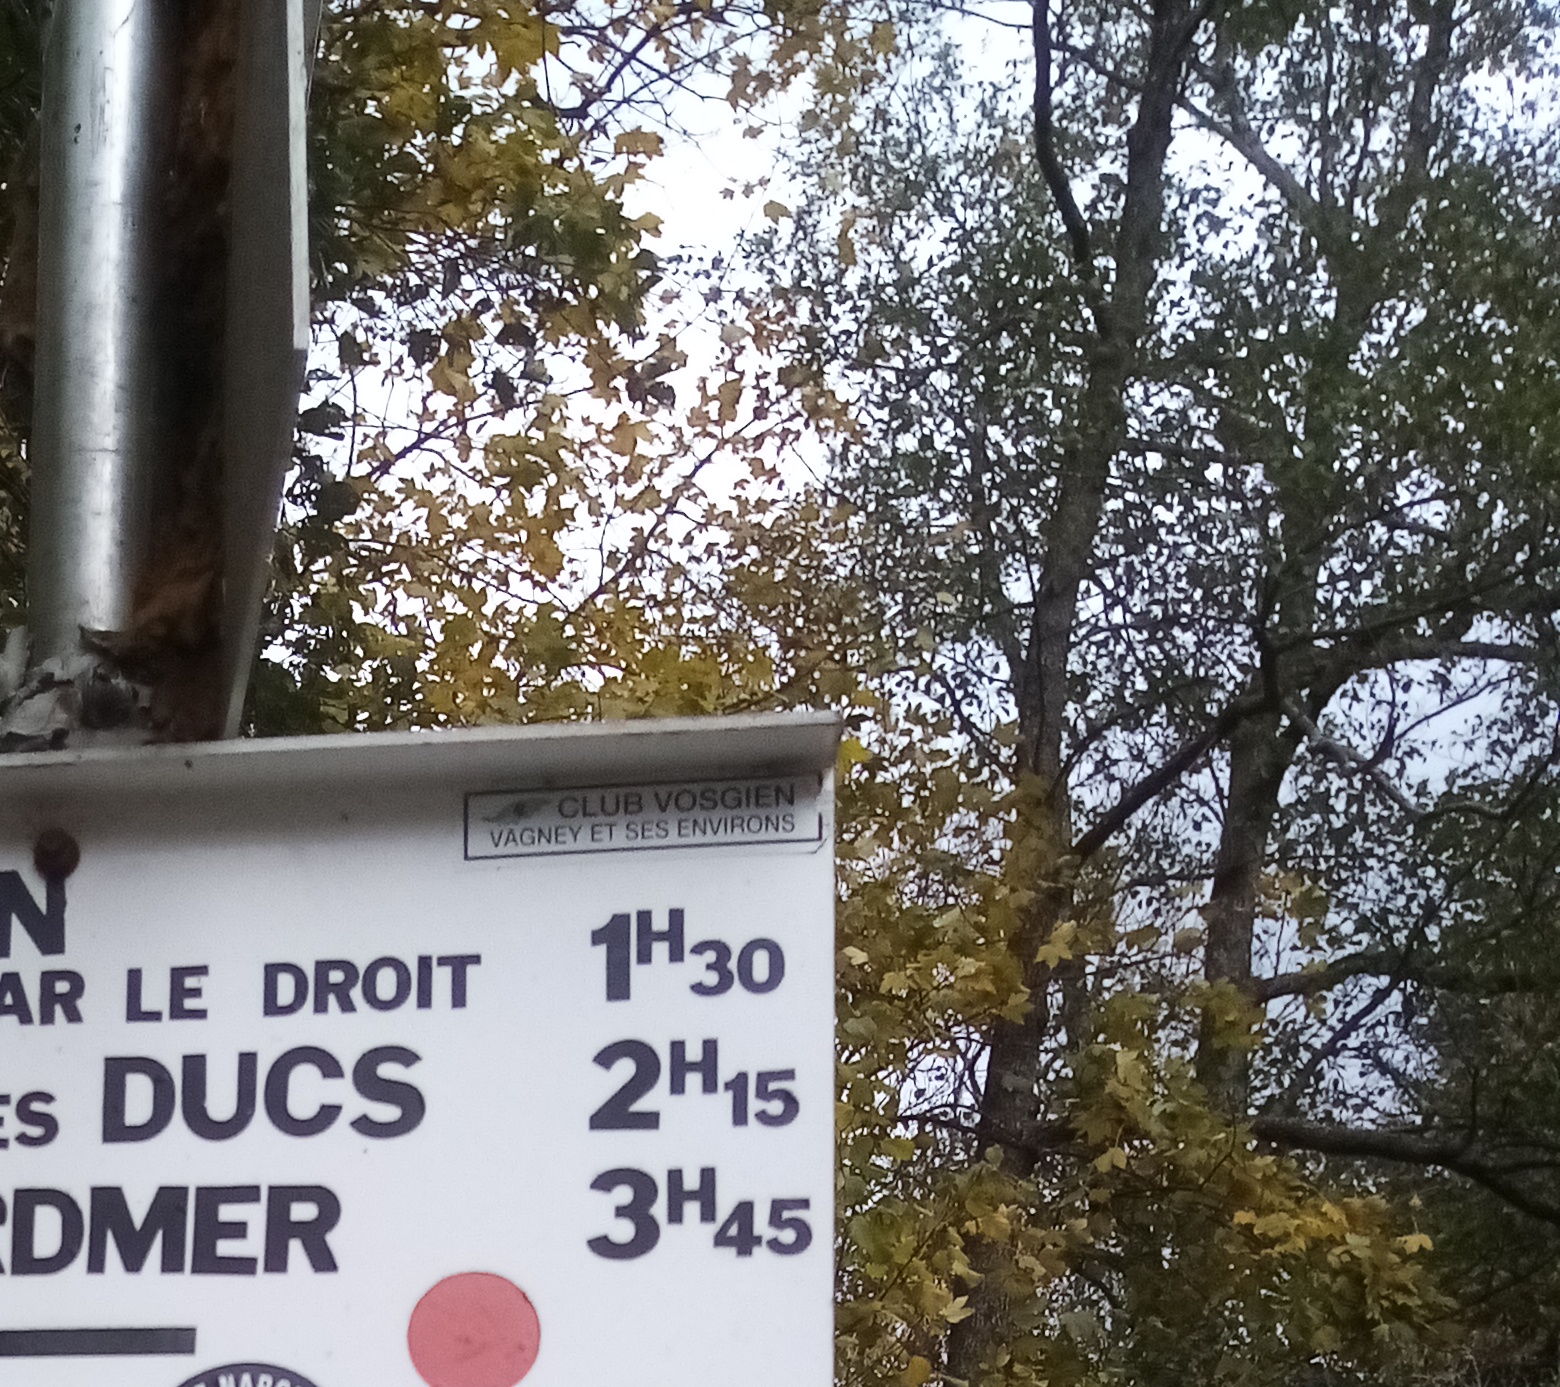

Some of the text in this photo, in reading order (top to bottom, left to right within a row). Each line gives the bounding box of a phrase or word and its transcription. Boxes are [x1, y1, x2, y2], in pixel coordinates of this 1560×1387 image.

[489, 813, 797, 850] VAGNEY ET SES ENVIRONS
[556, 782, 797, 820] CLUB VOSGIEN
[124, 963, 210, 1023] LE
[262, 953, 483, 1018] DROIT
[590, 907, 786, 1003] 1H30
[101, 1044, 427, 1145] DUCS
[588, 1037, 801, 1132] 2H15
[585, 1166, 814, 1261] 3H45
